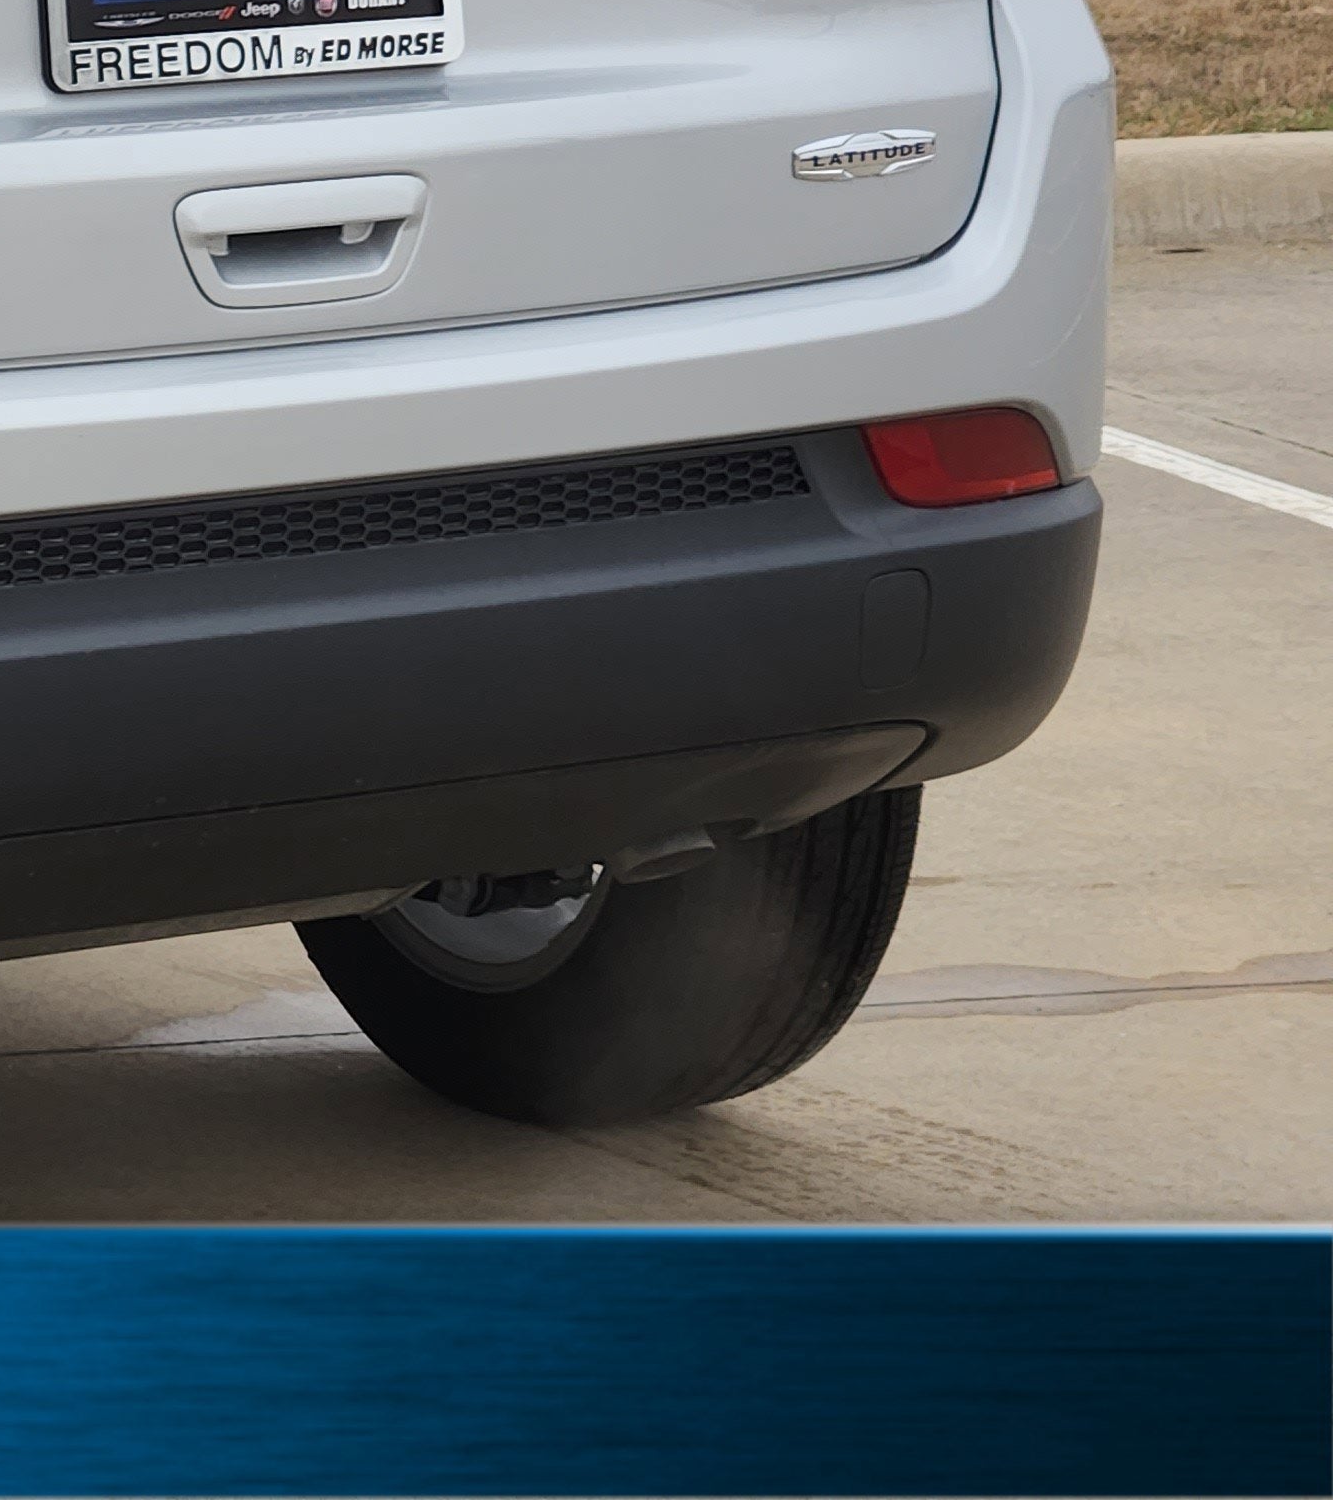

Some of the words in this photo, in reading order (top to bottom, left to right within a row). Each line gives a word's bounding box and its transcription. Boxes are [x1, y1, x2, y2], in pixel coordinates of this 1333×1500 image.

[240, 1, 282, 18] Jeep
[69, 35, 283, 85] FREEDOM
[320, 38, 351, 63] ED
[357, 31, 445, 60] MORSE
[812, 142, 927, 167] LATITUDE
